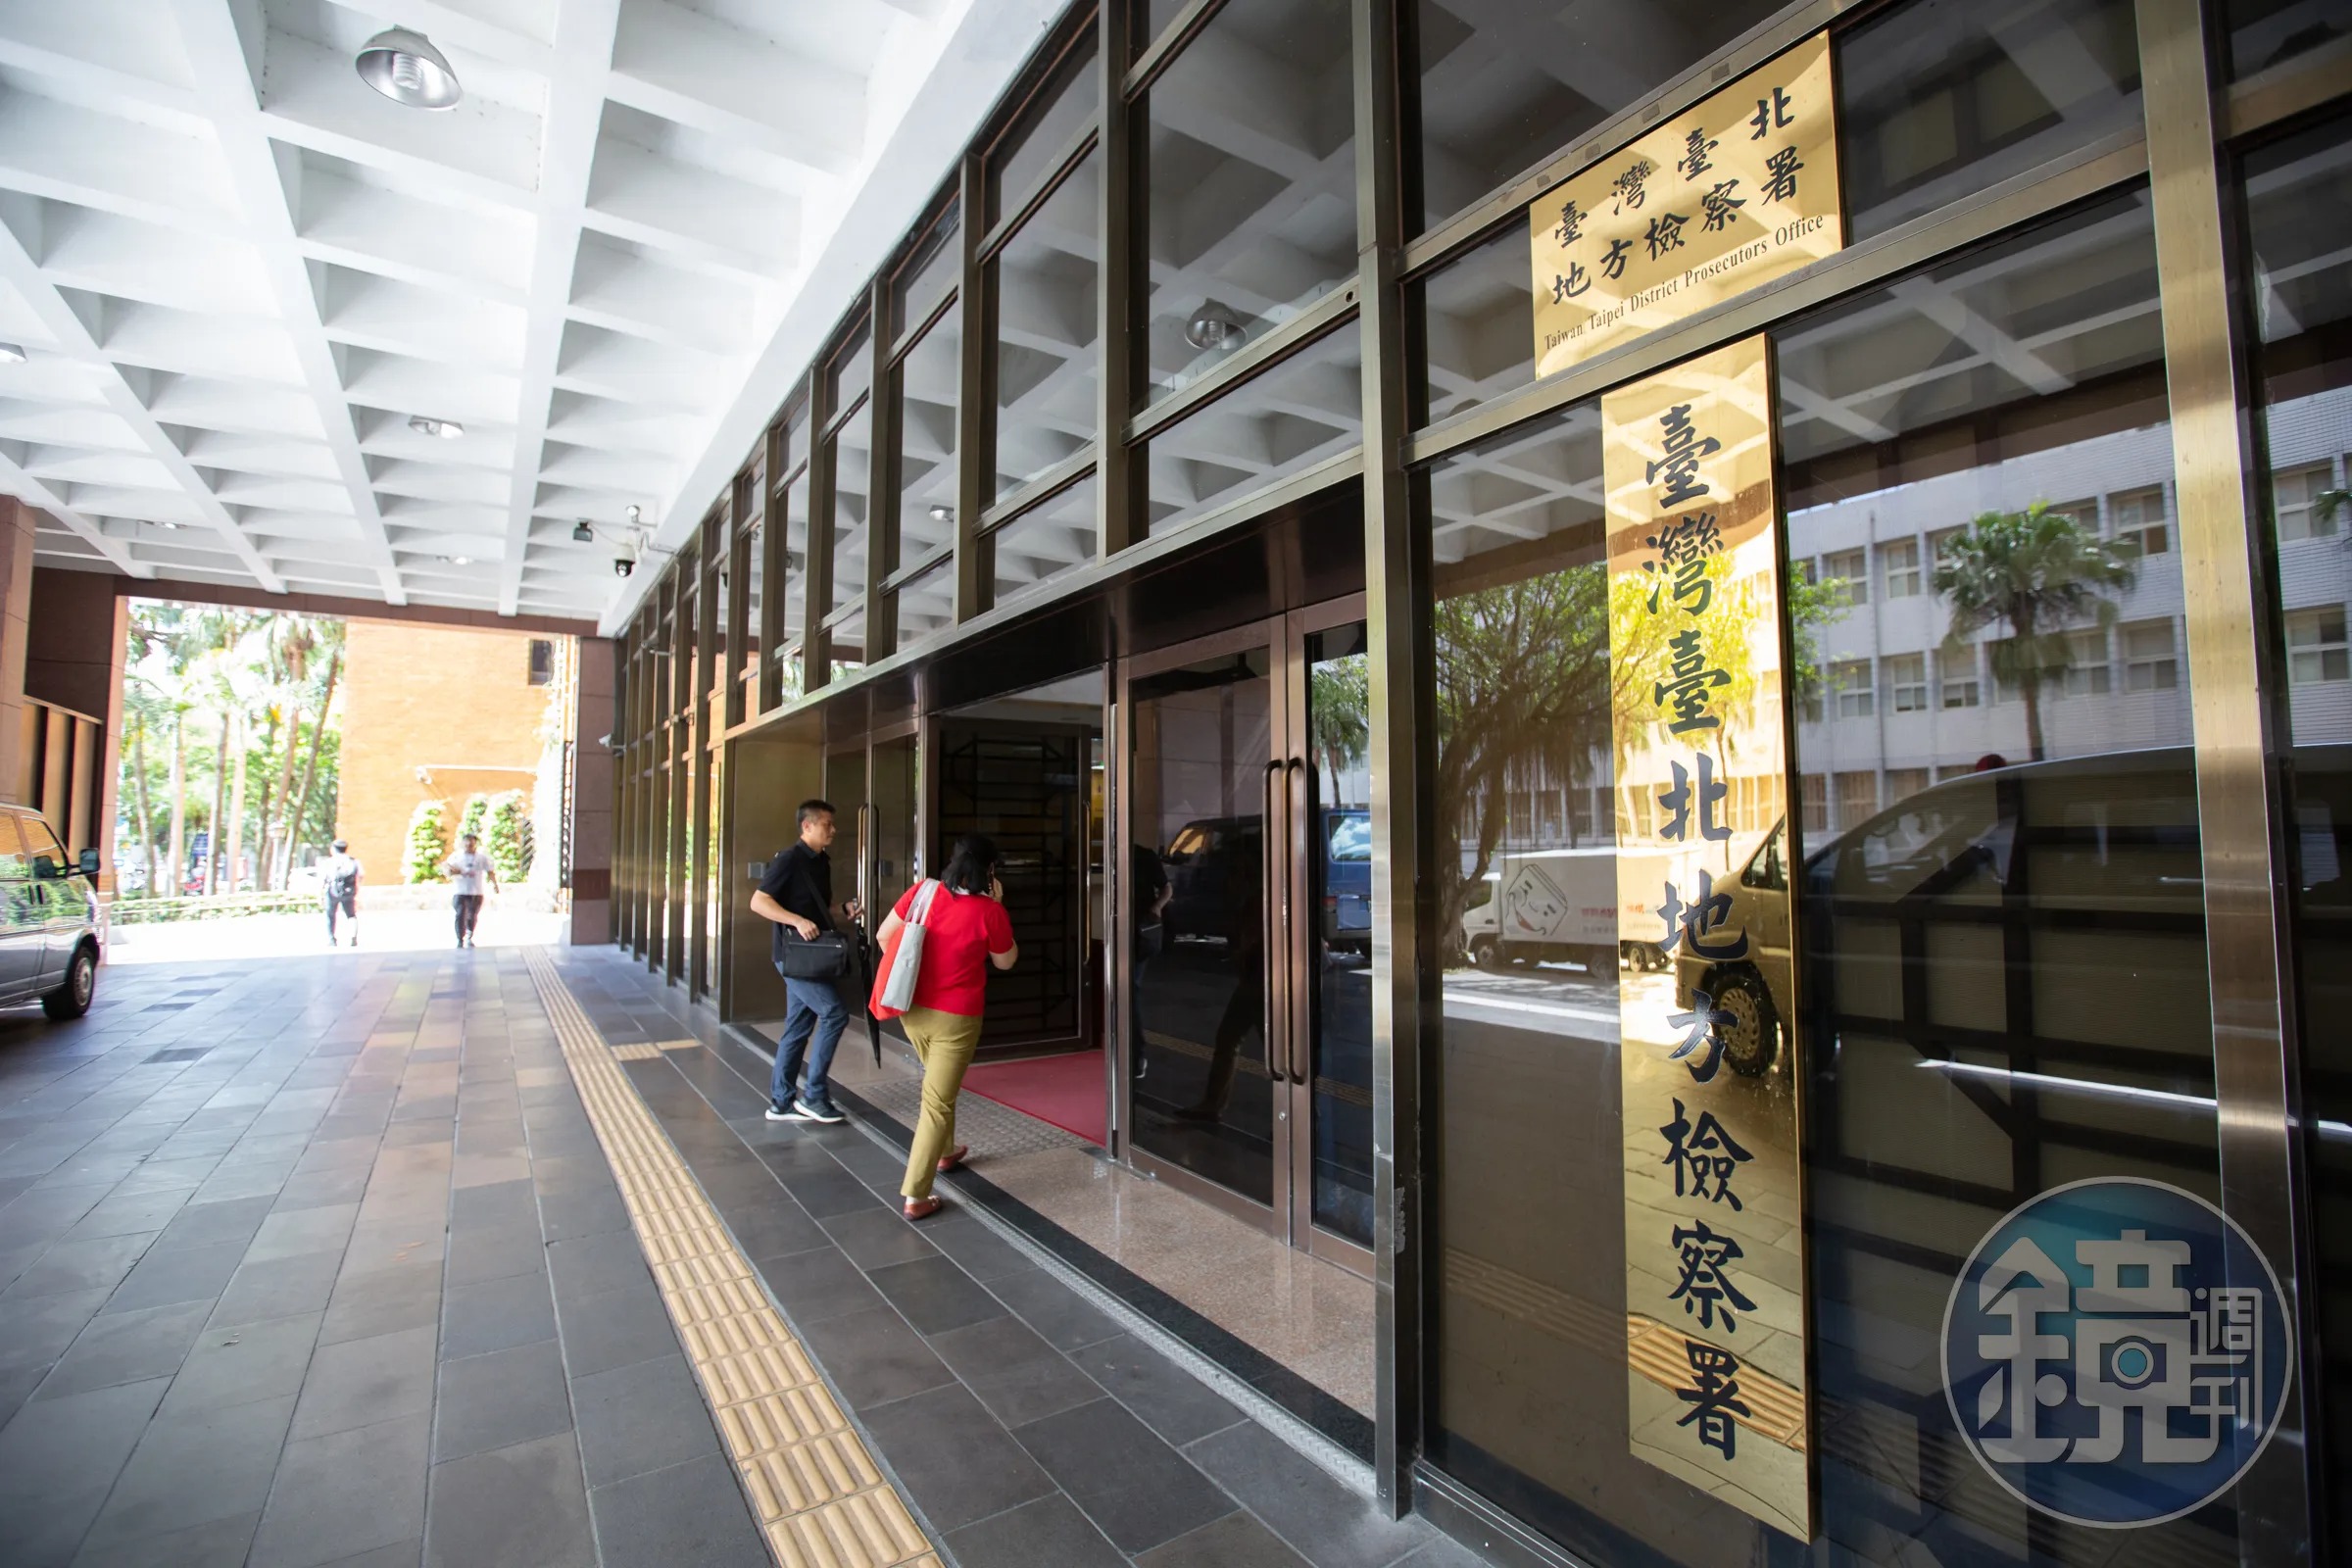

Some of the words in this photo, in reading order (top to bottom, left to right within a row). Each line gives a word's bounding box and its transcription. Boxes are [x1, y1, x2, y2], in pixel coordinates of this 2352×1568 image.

[1552, 145, 1804, 305] 地方檢察署
[1553, 87, 1795, 249] 臺灣臺北
[1544, 323, 1583, 350] Taiwan
[1588, 301, 1624, 330] Taipei
[1631, 278, 1678, 312] District
[1686, 240, 1767, 288] Prosecutors
[1776, 215, 1823, 246] Office
[1642, 403, 1758, 1461] 臺灣臺北地方檢察署
